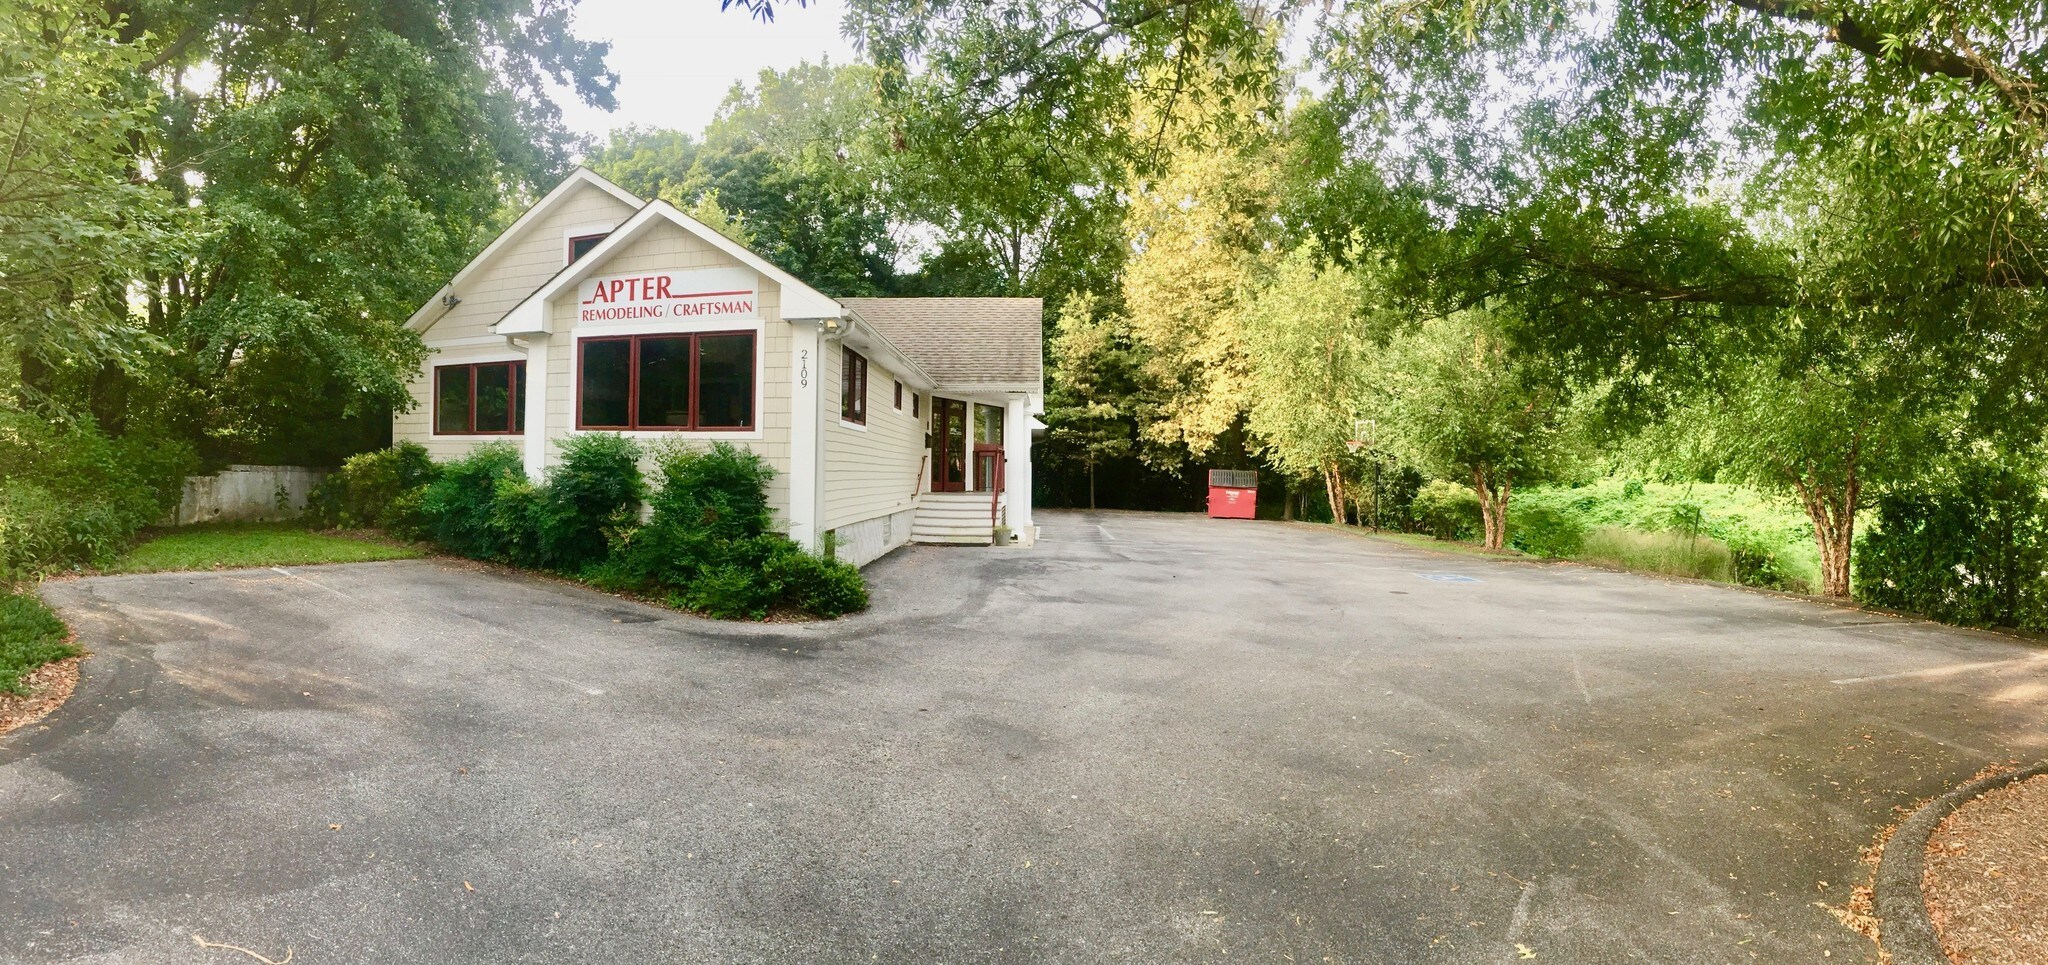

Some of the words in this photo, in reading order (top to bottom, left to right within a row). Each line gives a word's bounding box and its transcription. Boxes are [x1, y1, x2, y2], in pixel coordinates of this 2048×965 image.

[592, 275, 673, 304] APTER
[582, 304, 663, 321] REMODELING
[673, 300, 753, 317] CRAFTSMAN
